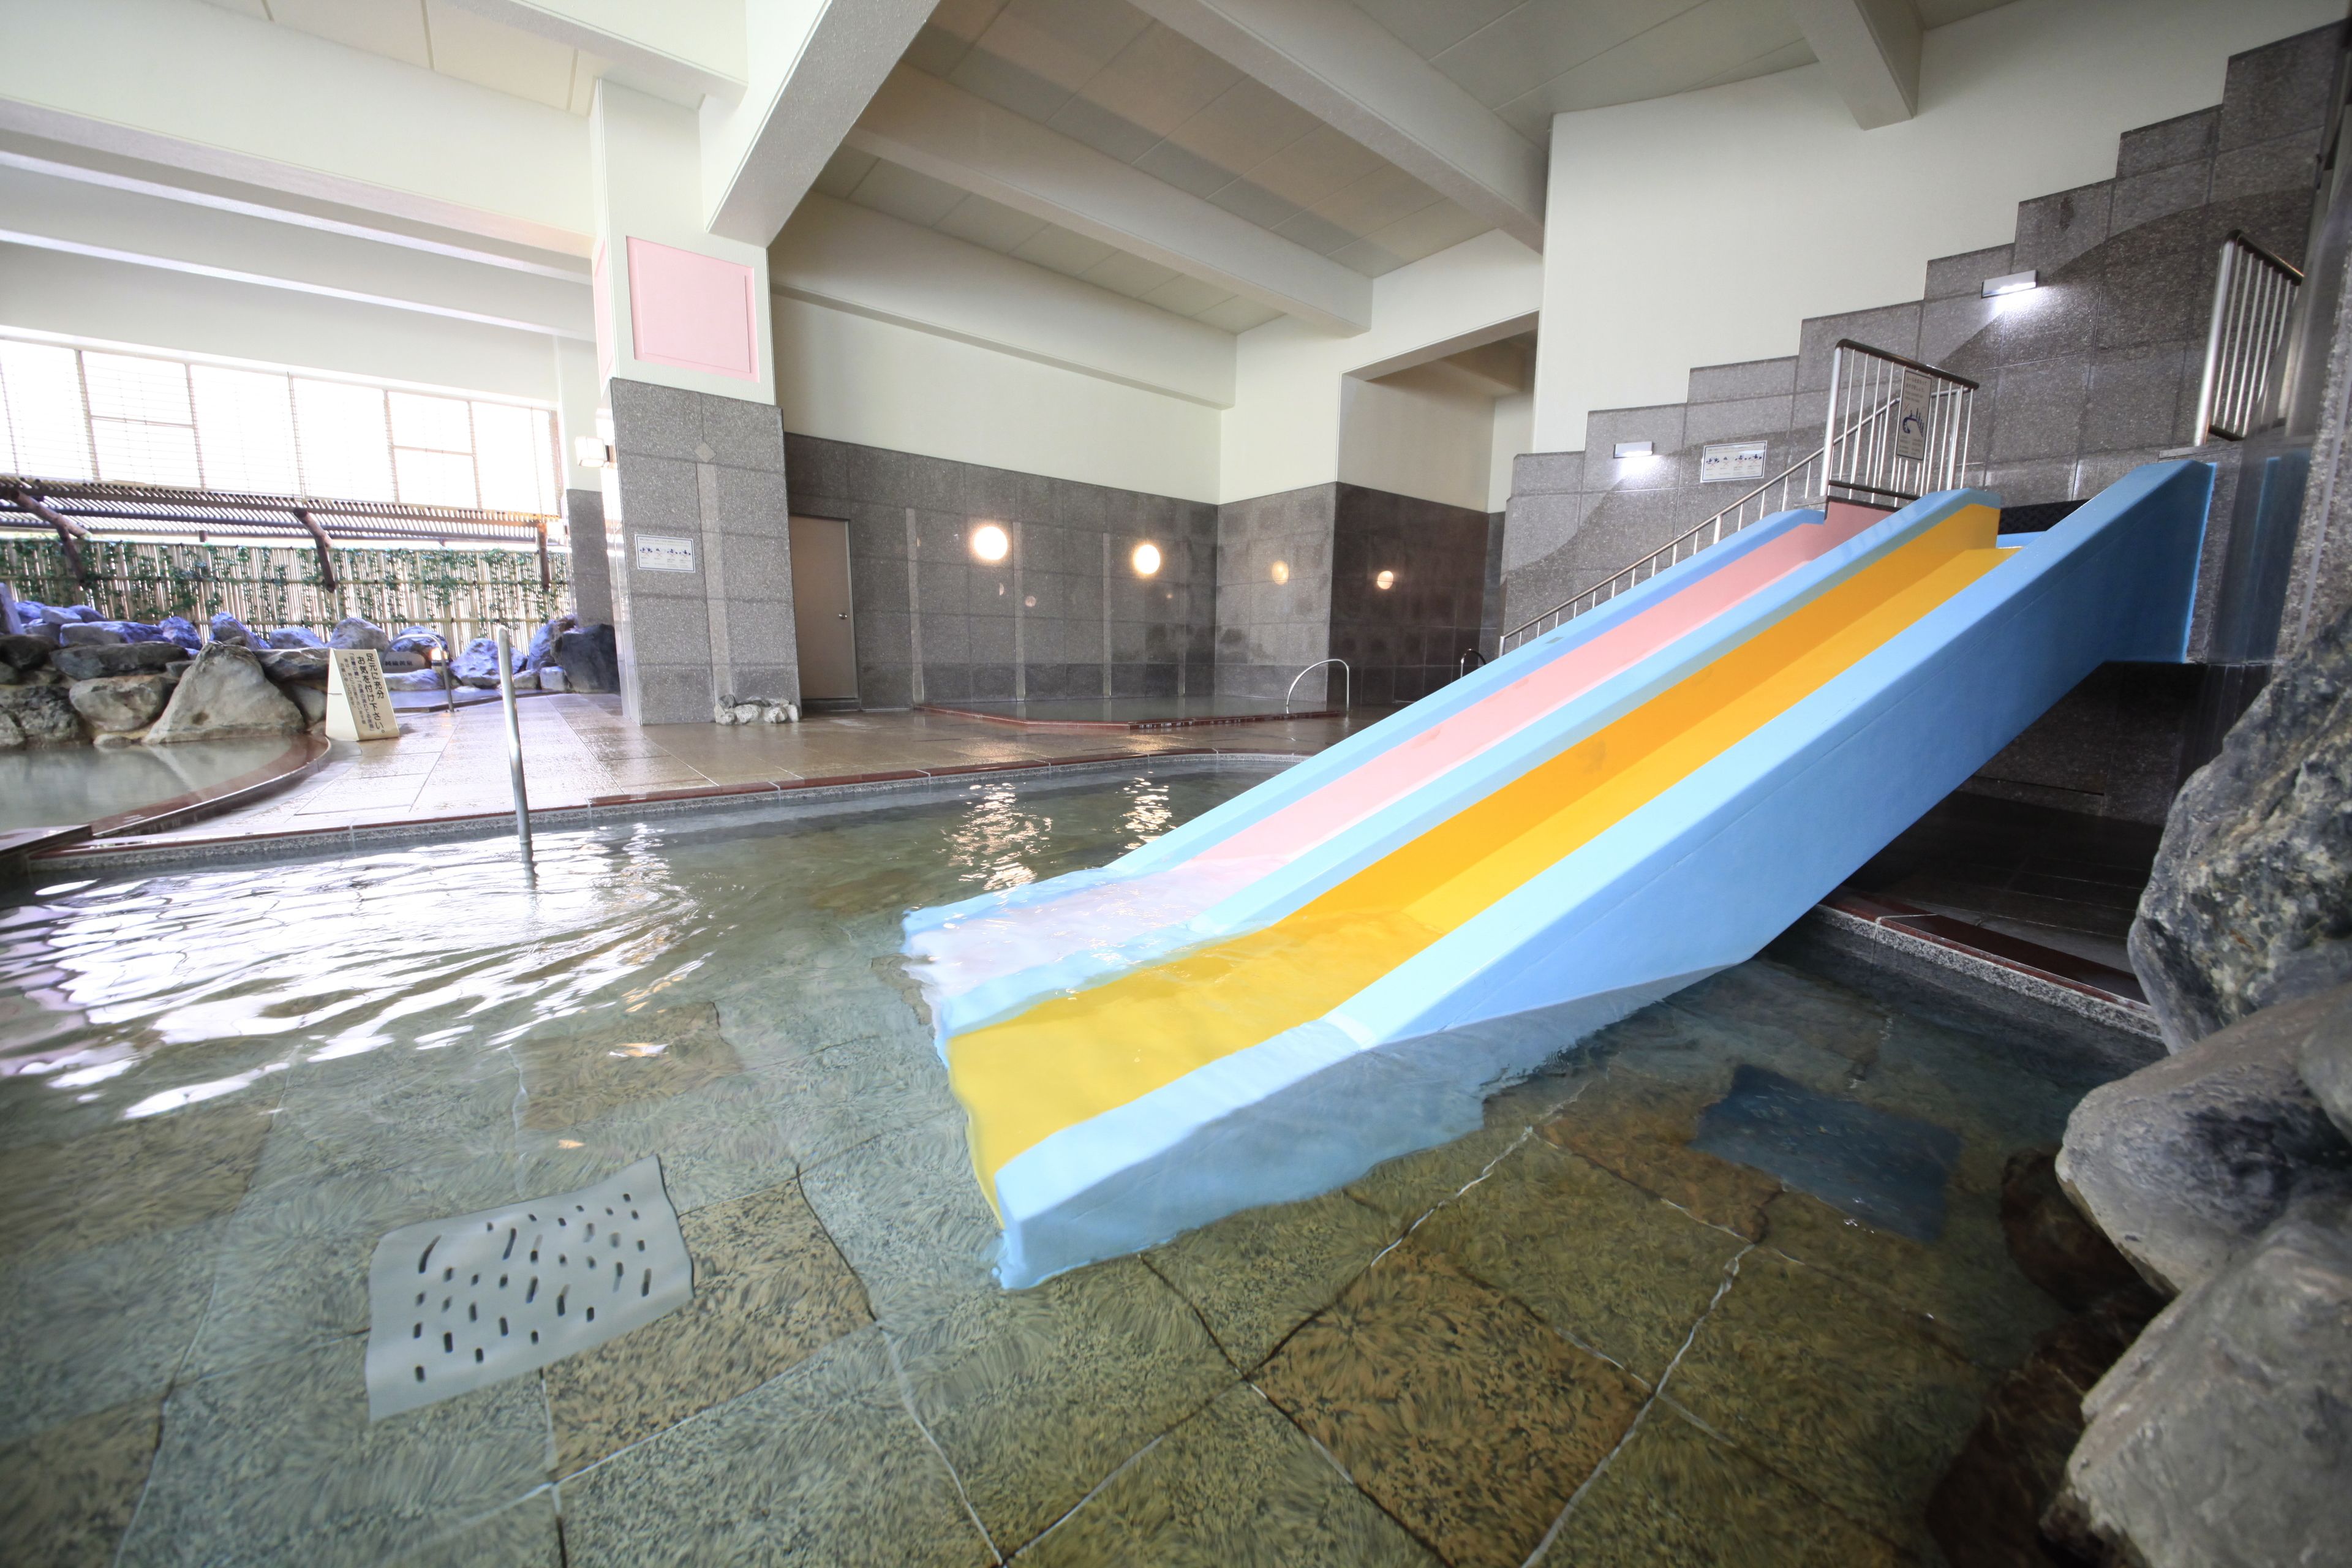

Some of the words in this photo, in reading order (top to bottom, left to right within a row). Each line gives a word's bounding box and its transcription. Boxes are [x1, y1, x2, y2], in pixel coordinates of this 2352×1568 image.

[356, 656, 385, 733] お気を付け下さい。
[366, 653, 384, 699] 足元に充分
